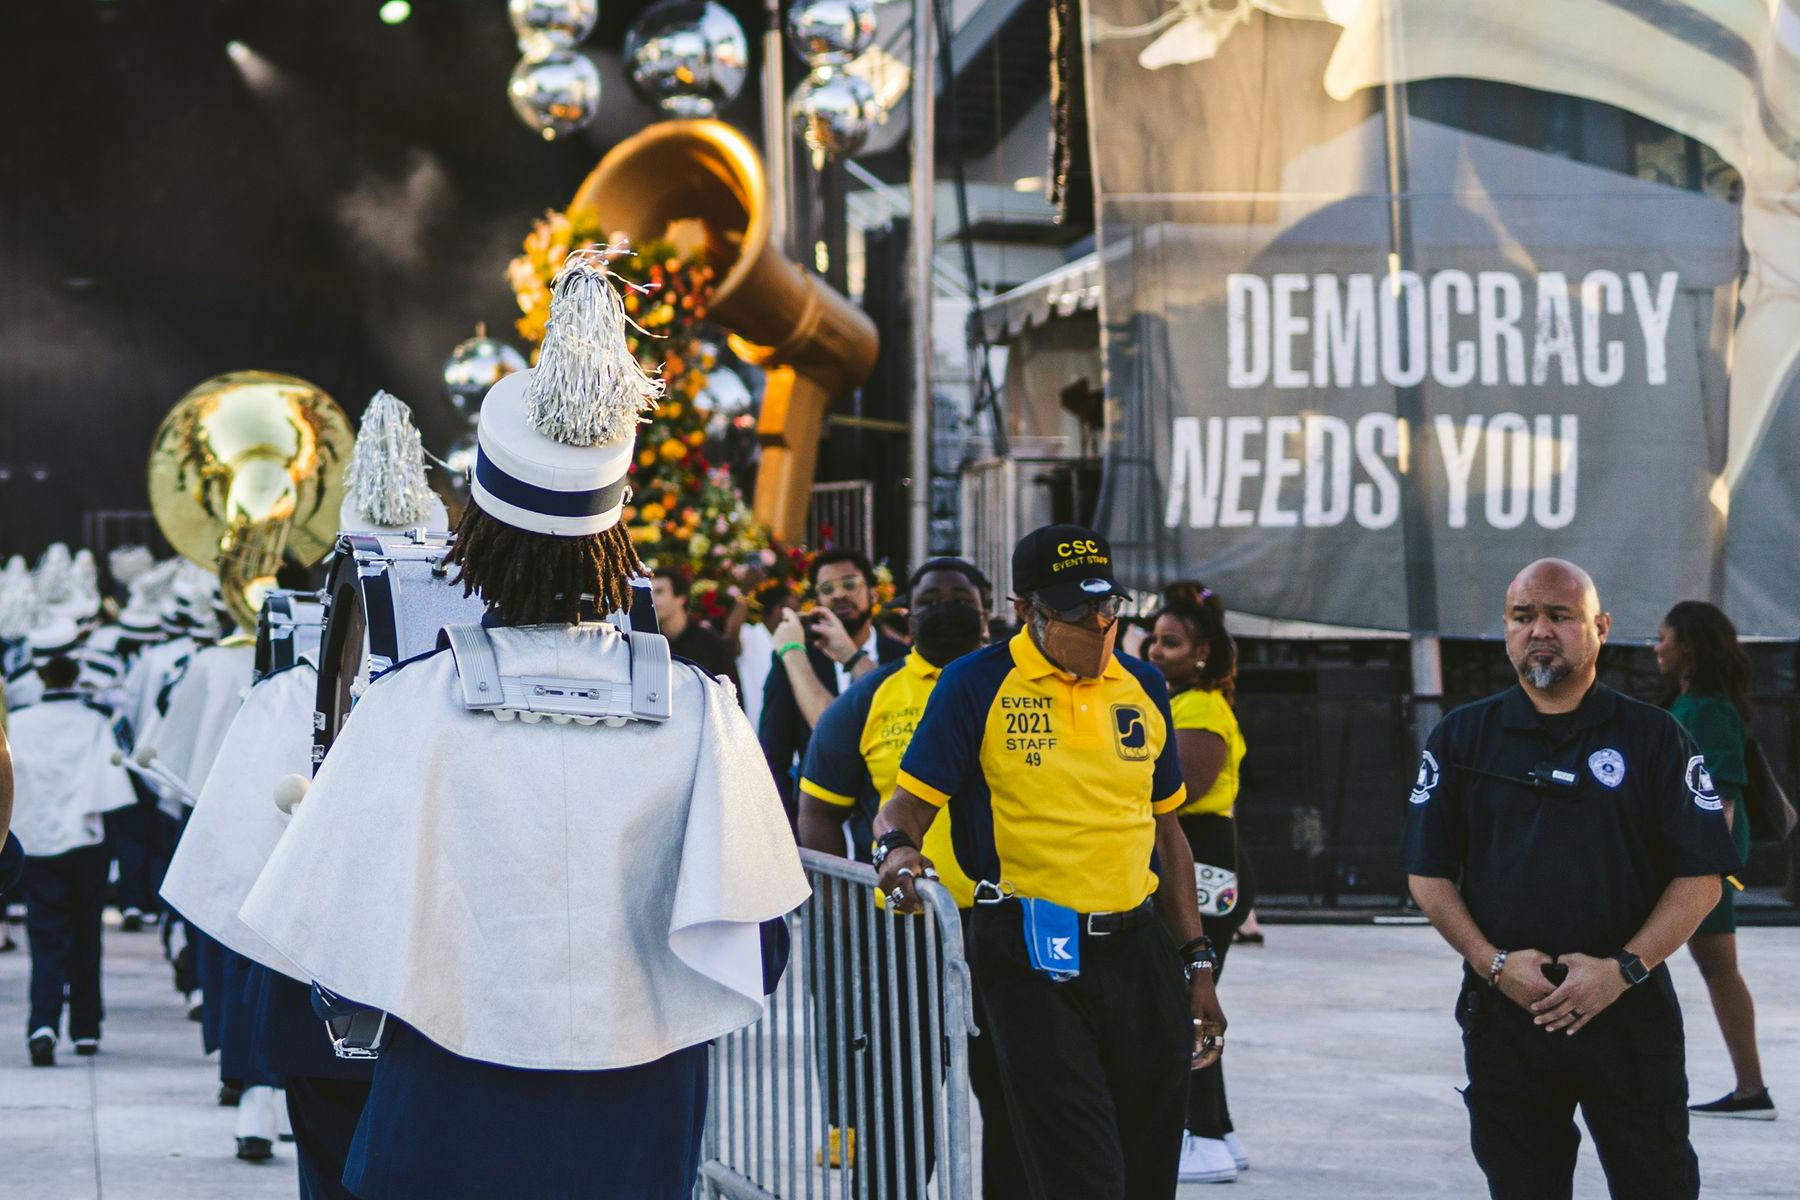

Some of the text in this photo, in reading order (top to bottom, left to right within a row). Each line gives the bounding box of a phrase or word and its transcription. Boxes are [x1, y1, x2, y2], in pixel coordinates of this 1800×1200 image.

[1226, 269, 1679, 389] DEMOCRACY
[1164, 411, 1579, 531] NEEDS YOU
[1057, 540, 1098, 557] CSC
[1052, 557, 1084, 571] EVENT
[1002, 696, 1053, 709] EVENT
[1006, 712, 1053, 734] 2021
[1006, 738, 1057, 751] STAFF
[1025, 752, 1042, 767] 49
